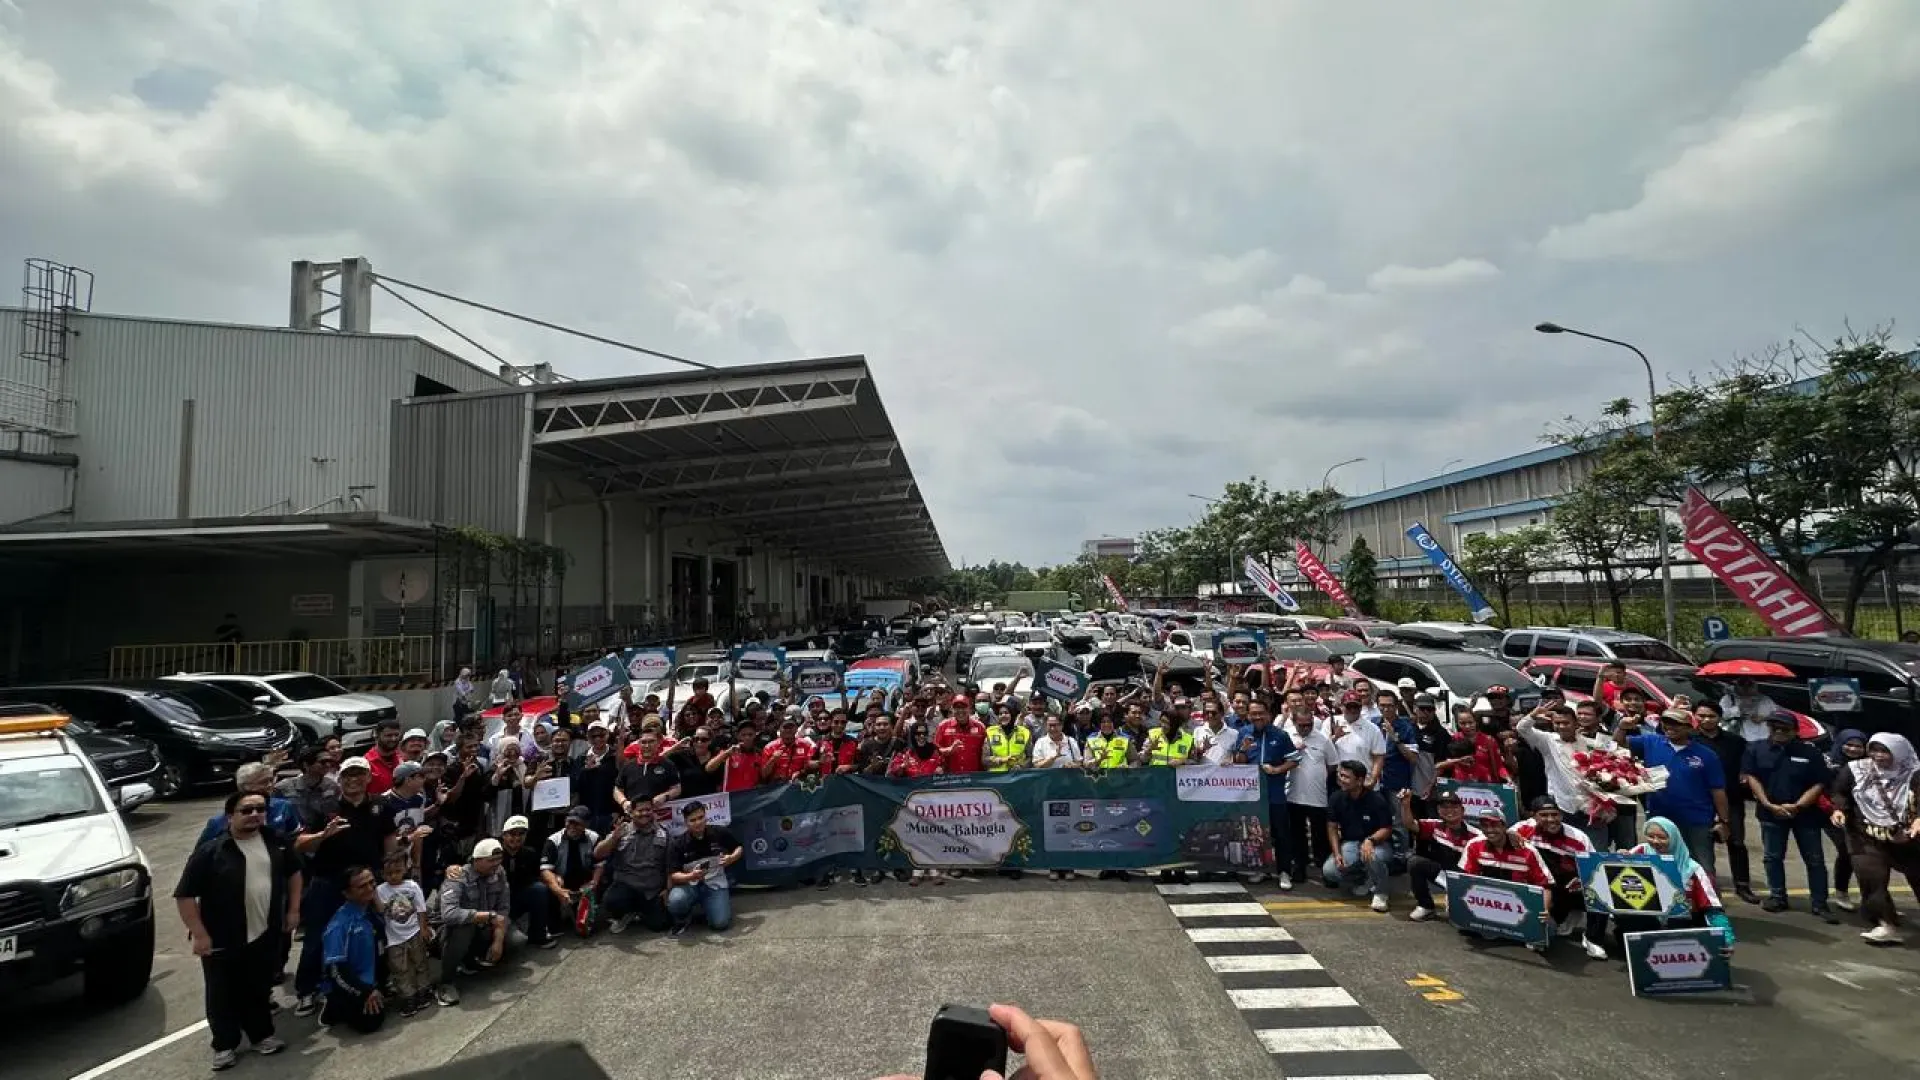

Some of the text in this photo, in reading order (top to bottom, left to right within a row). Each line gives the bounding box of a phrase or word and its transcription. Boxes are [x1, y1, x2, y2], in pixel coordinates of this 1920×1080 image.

[1707, 620, 1722, 638] P
[915, 802, 993, 819] DAIHATSU
[1468, 895, 1513, 913] JUARA
[1650, 952, 1697, 965] JUARA
